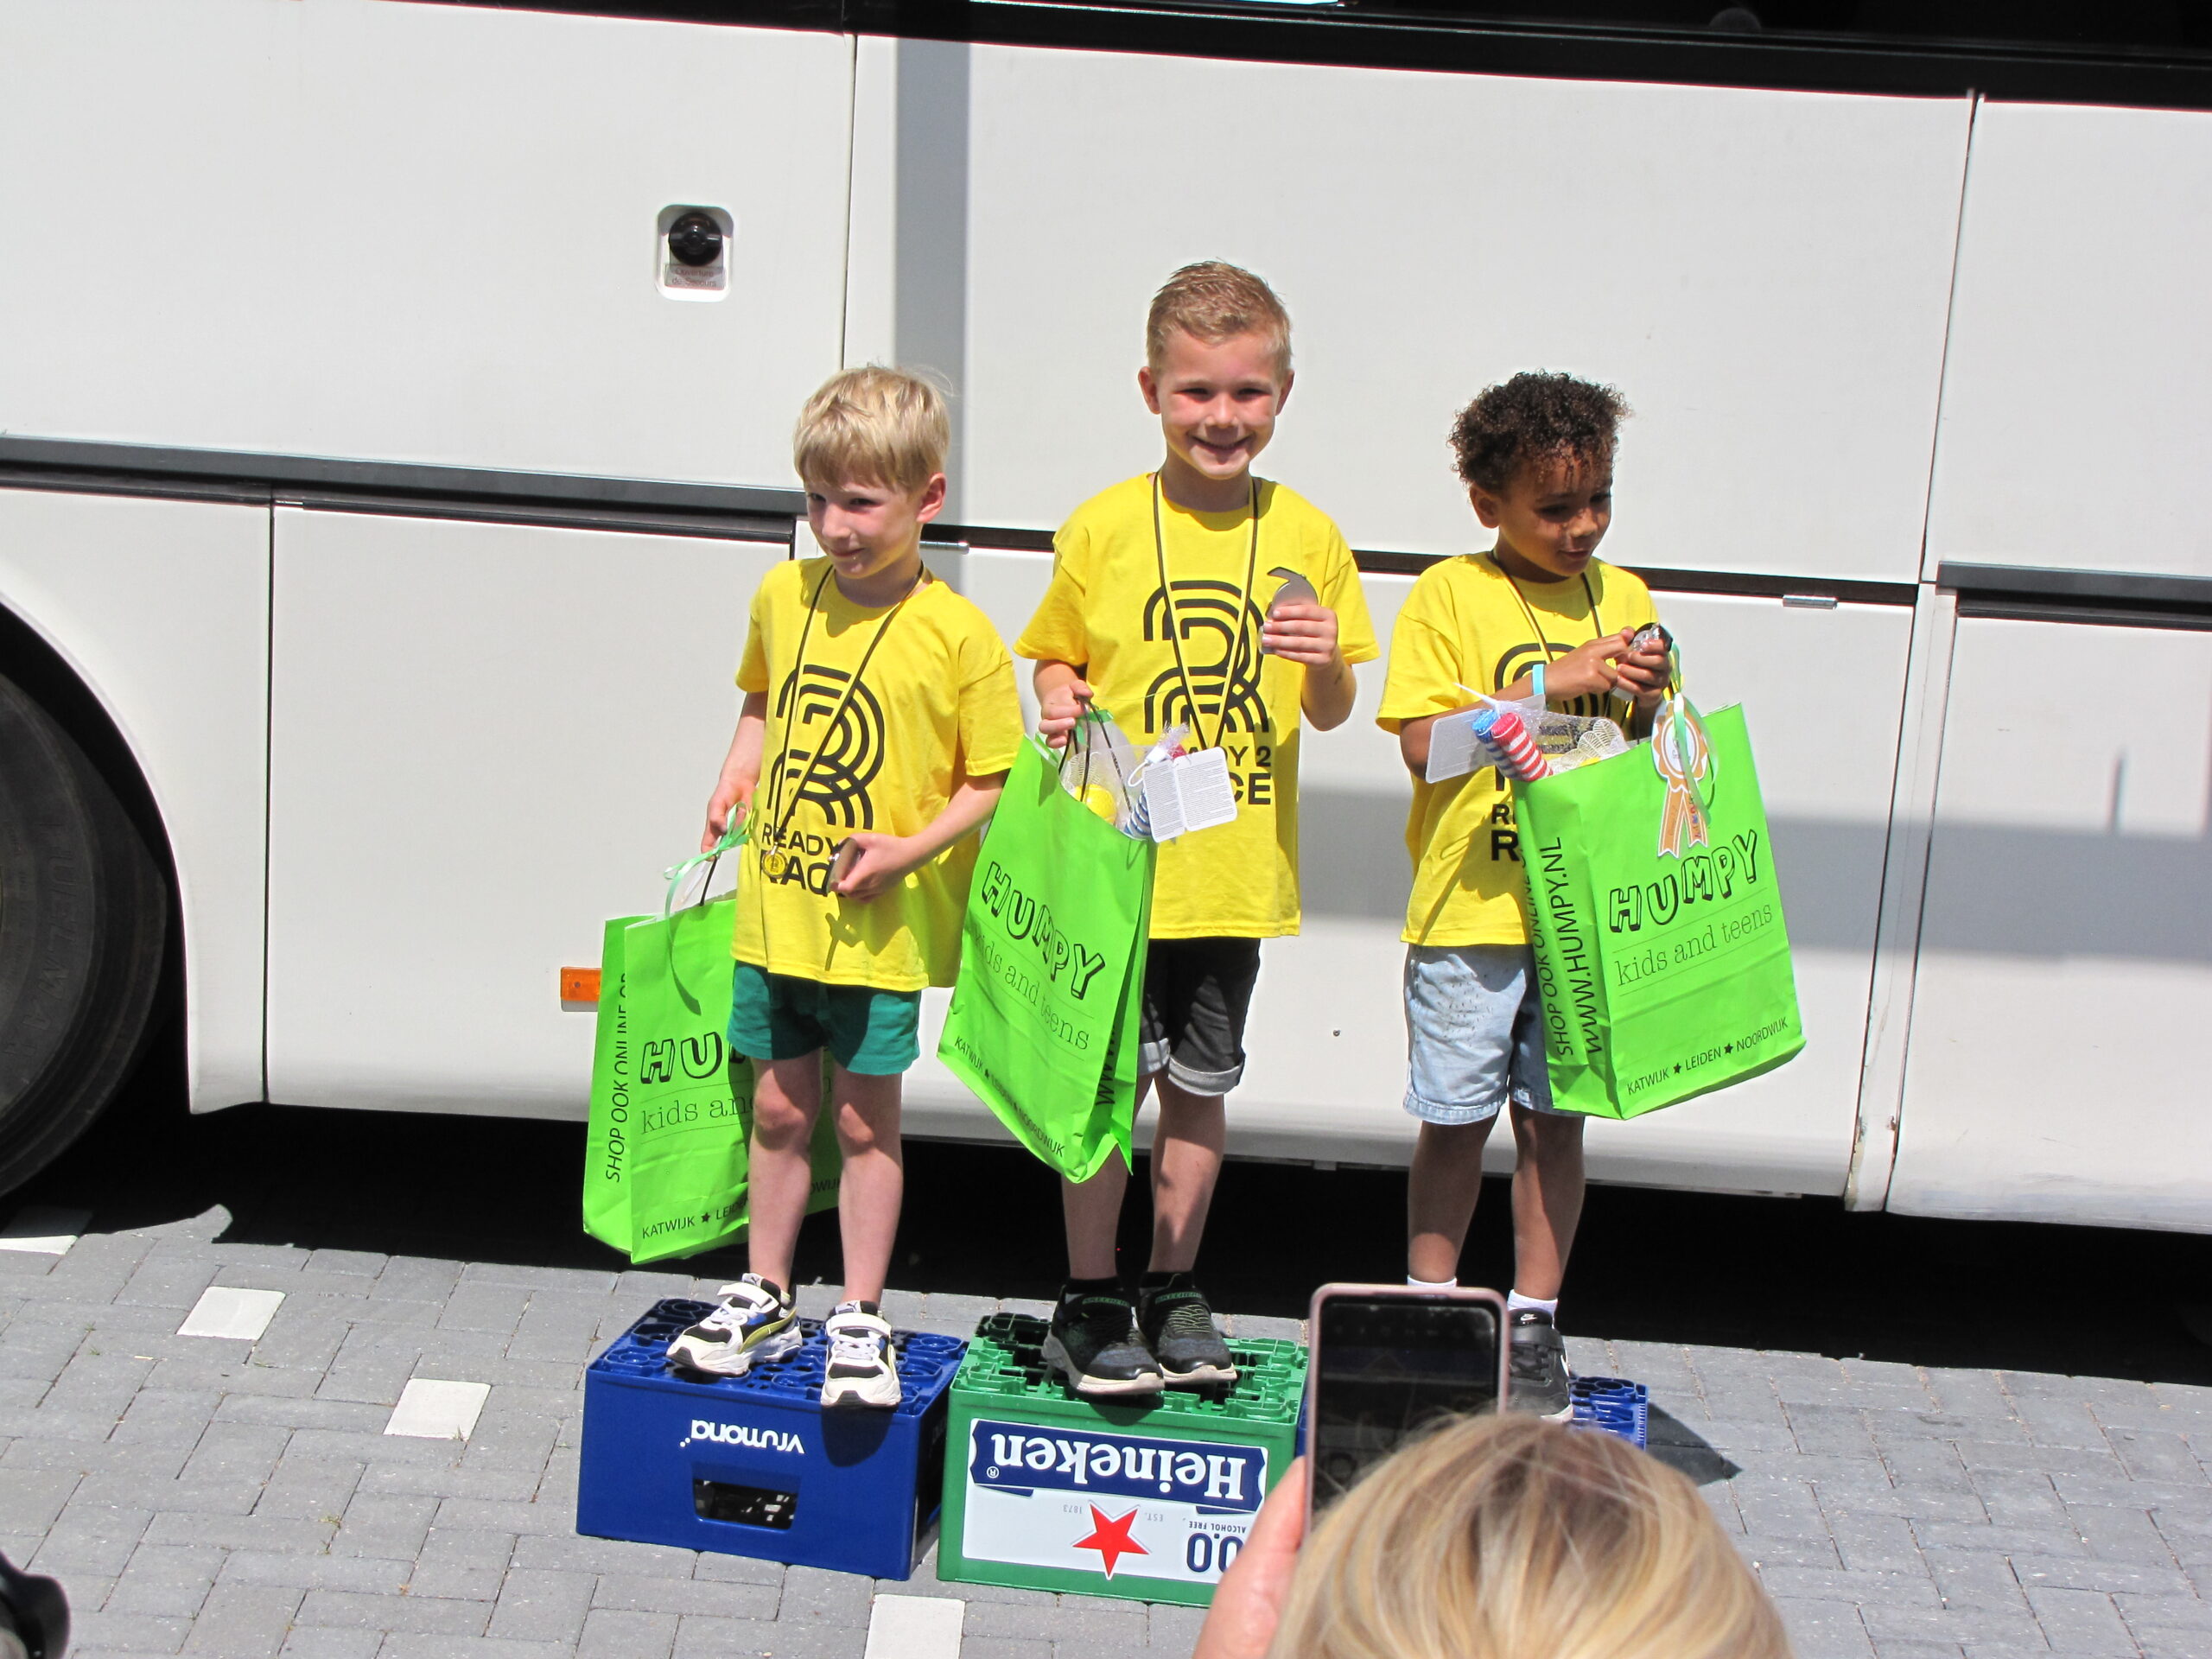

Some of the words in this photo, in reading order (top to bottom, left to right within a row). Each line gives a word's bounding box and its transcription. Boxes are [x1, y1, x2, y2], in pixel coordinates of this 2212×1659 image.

[685, 277, 717, 288] Secours
[1255, 746, 1271, 767] 2
[1609, 829, 1758, 934] HUMPY
[982, 861, 1107, 1001] HUMPY
[1539, 836, 1603, 1054] WWW.HUMPY.NL
[1614, 949, 1669, 988] kids
[1674, 925, 1718, 963] and
[1720, 904, 1773, 946] teens
[973, 928, 1003, 974] kids
[1004, 963, 1041, 1007] and
[1040, 994, 1090, 1051] teens
[1535, 953, 1558, 999] OOK
[1547, 1001, 1574, 1057] SHOP
[1626, 1067, 1670, 1096] KATWIJK
[1684, 1046, 1723, 1072] LEIDEN
[1735, 1016, 1789, 1053] NOORDWIJK
[610, 1079, 630, 1124] OOK
[641, 1099, 699, 1135] kids
[605, 1127, 626, 1184] SHOP
[642, 1215, 696, 1240] KATWIJK
[690, 1419, 805, 1455] vrumona
[990, 1433, 1247, 1501] Heineken
[1063, 1504, 1083, 1515] 1873
[1188, 1520, 1208, 1529] FREE
[1211, 1522, 1247, 1534] ALCOHOL
